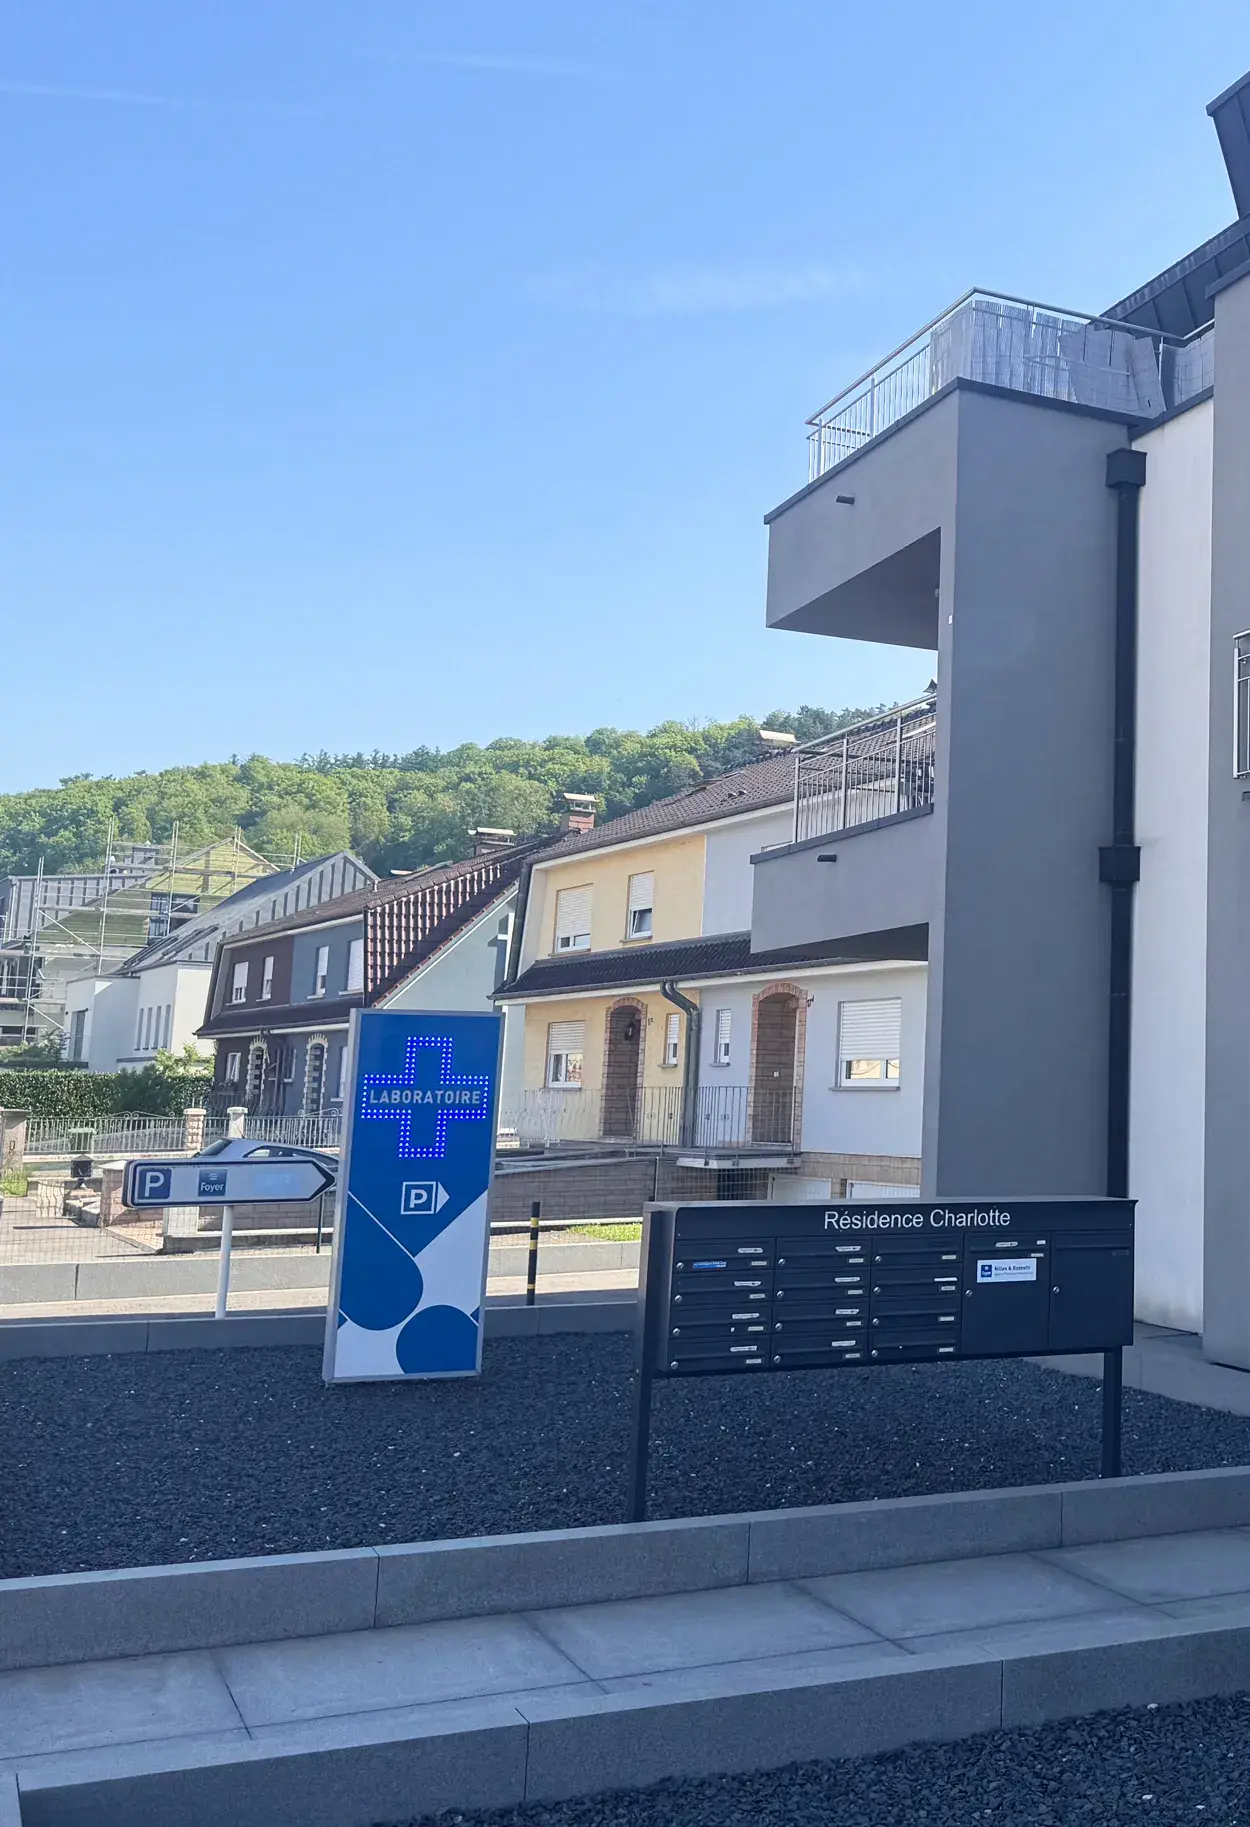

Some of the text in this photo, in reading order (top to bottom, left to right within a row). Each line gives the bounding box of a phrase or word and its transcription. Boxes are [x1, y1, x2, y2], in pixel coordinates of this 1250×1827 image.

[369, 1089, 481, 1104] LABORATOIRE
[144, 1171, 165, 1198] P
[200, 1182, 224, 1192] Foyer
[410, 1189, 428, 1208] P
[824, 1209, 1011, 1230] Résidence Charlotte
